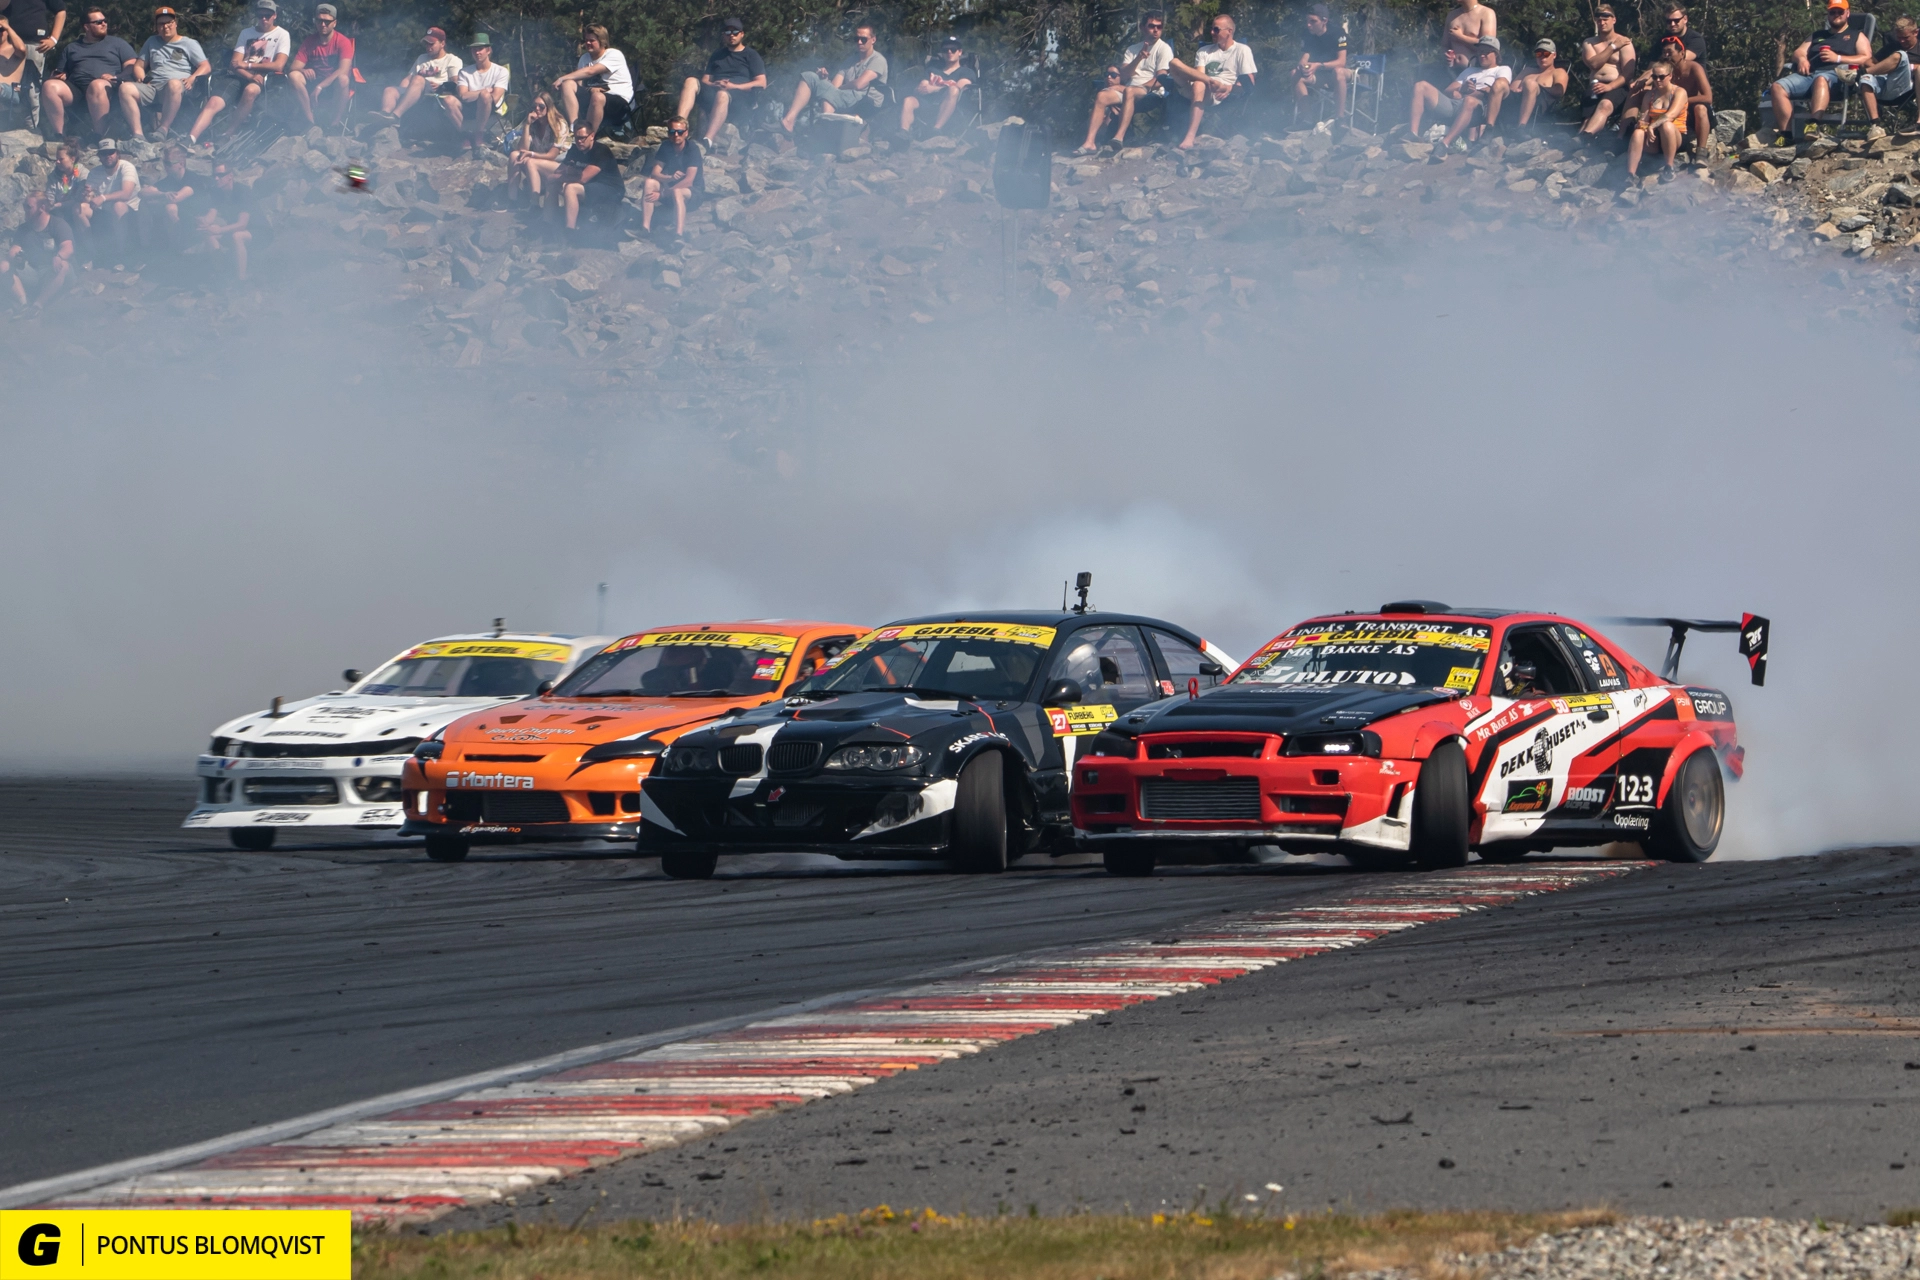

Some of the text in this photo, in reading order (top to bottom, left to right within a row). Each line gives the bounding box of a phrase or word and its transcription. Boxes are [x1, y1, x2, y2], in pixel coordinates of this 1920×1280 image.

[877, 629, 902, 638] 27
[914, 626, 996, 636] GATEBIL
[1327, 630, 1415, 641] GATEBIL
[1355, 621, 1453, 634] TRANSPORT
[1458, 626, 1488, 638] AS
[622, 638, 636, 647] 11
[655, 634, 732, 643] GATEBIL
[1271, 639, 1297, 651] 50
[1282, 644, 1419, 658] MR BAKKE AS
[1603, 657, 1615, 674] A
[1292, 670, 1398, 685] PLUTO
[1552, 699, 1570, 713] 50
[1694, 699, 1727, 715] GROUP
[1052, 714, 1066, 730] 27
[1067, 711, 1095, 721] FURBERG
[1476, 727, 1492, 741] MR
[1508, 708, 1519, 722] AS
[1500, 746, 1534, 779] DEKK
[1546, 721, 1576, 751] HUSET
[1568, 787, 1606, 803] BOOST
[1613, 813, 1650, 830] Opplæring
